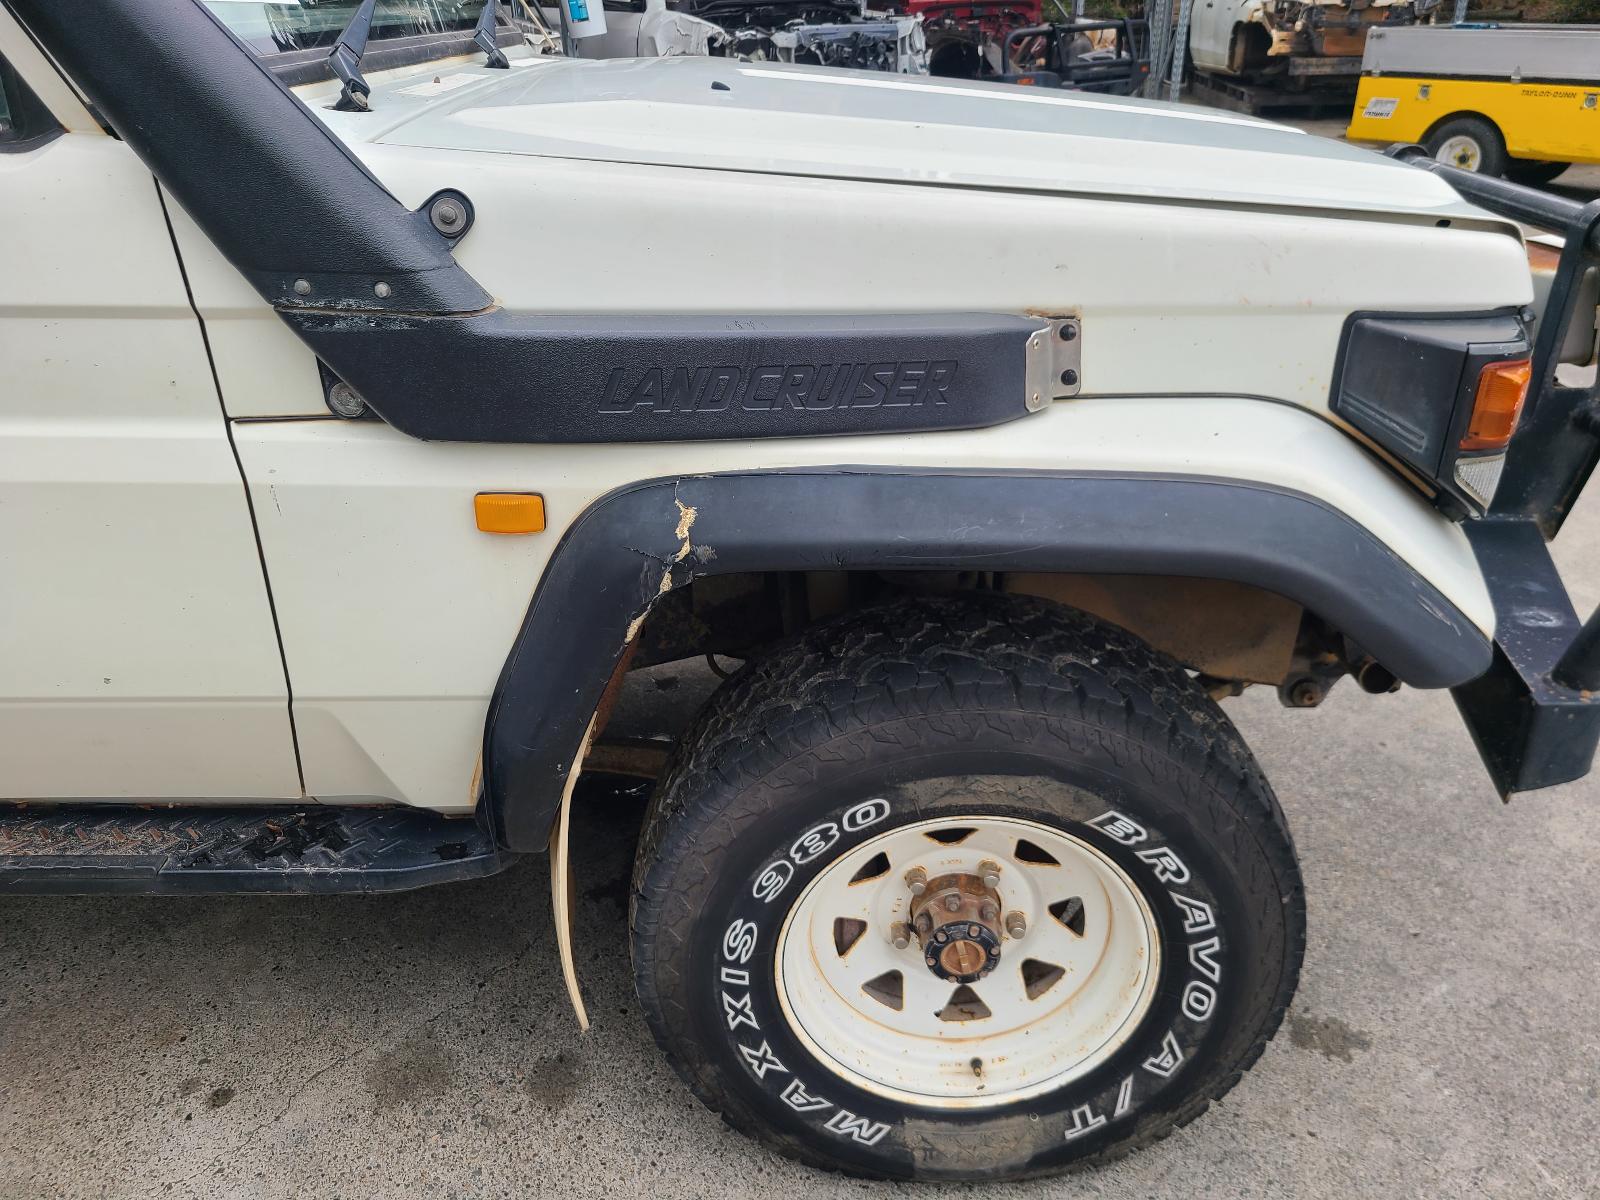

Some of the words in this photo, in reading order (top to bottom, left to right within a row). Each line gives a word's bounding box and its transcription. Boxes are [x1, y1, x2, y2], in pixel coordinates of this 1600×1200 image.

[752, 798, 891, 904] 980
[1084, 809, 1221, 1022] BRAVO
[720, 918, 892, 1146] MAXXIS
[1064, 1030, 1184, 1141] A/T
